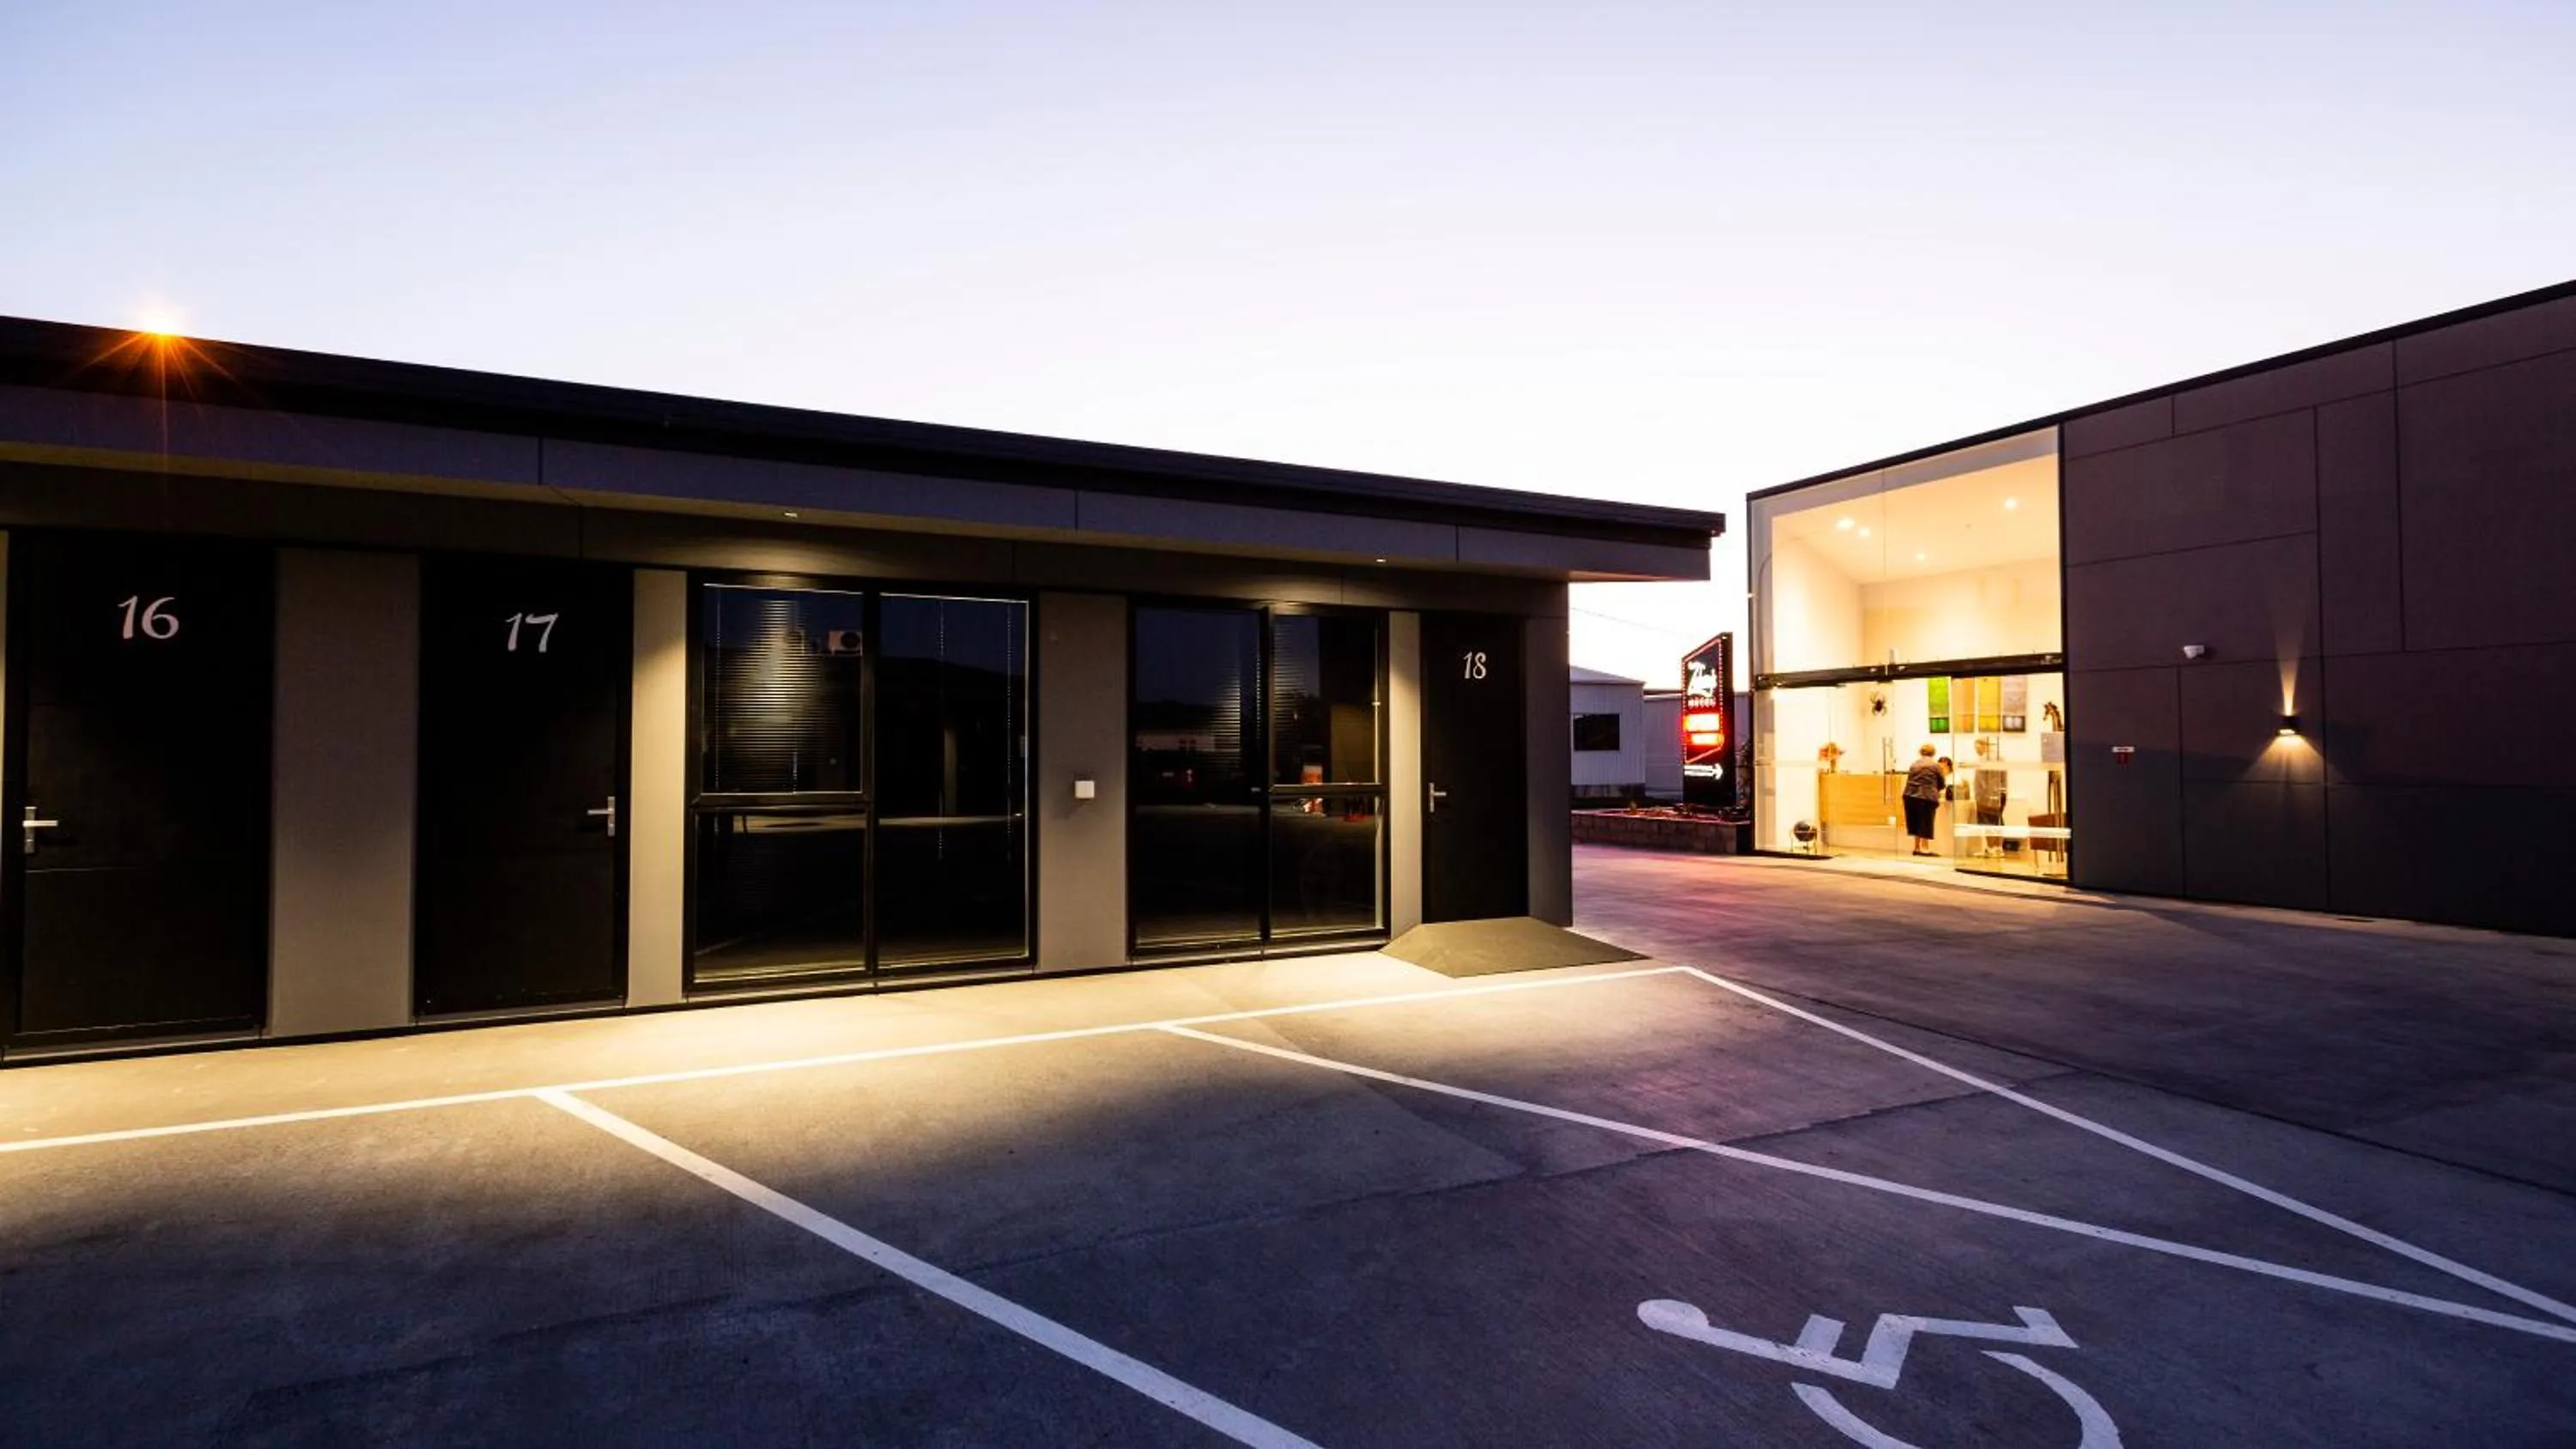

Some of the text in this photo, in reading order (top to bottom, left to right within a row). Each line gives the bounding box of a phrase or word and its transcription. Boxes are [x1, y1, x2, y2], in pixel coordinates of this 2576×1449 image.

[118, 595, 179, 639] 16
[506, 612, 558, 652] 17
[1462, 651, 1486, 679] 18
